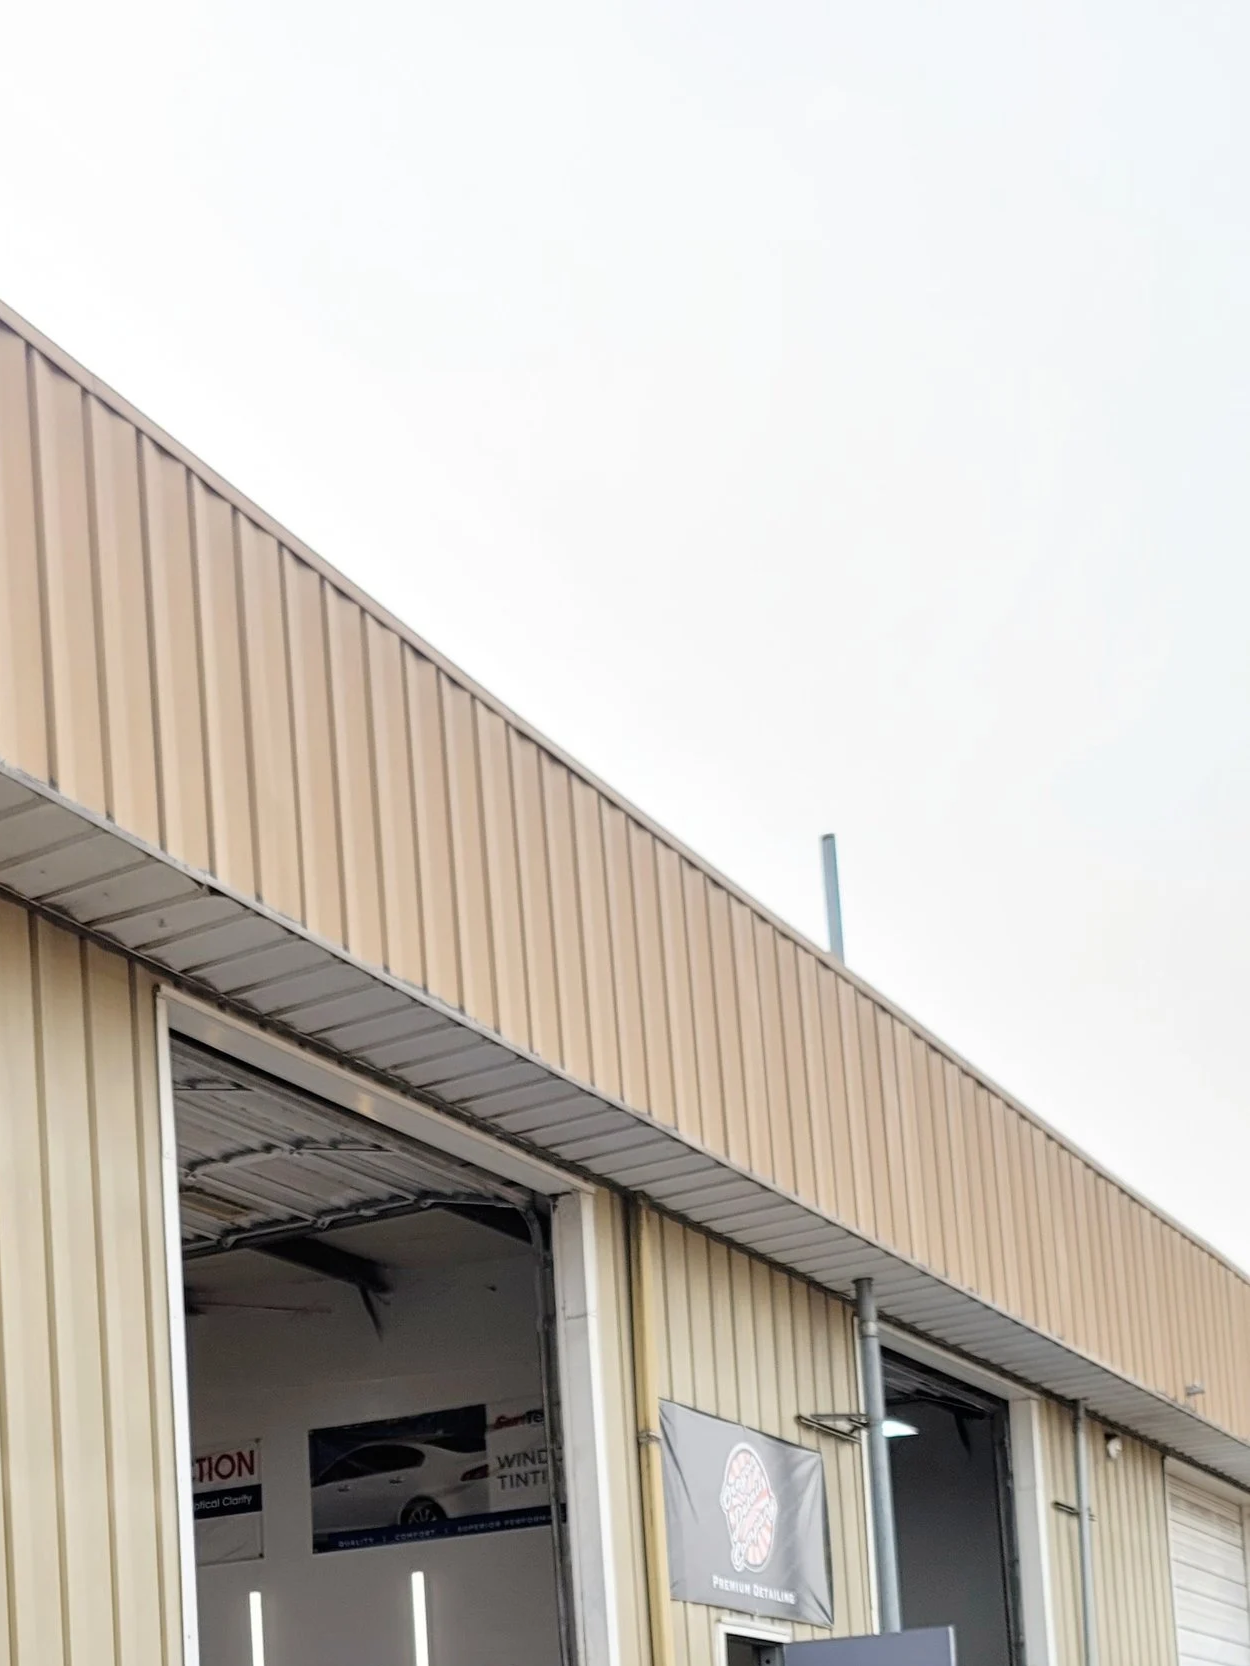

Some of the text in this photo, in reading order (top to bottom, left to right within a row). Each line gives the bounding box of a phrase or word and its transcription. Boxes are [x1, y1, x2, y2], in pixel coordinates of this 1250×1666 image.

[493, 1409, 545, 1430] SunTe
[192, 1449, 254, 1482] TION
[497, 1448, 548, 1469] WIND
[496, 1470, 547, 1490] TINTI
[194, 1494, 253, 1511] ptical Clarity
[338, 1537, 375, 1548] QUALITY
[395, 1529, 436, 1542] COMFORT
[457, 1521, 501, 1533] SUPERIOR
[712, 1574, 796, 1605] PREMIUM DETAILING
